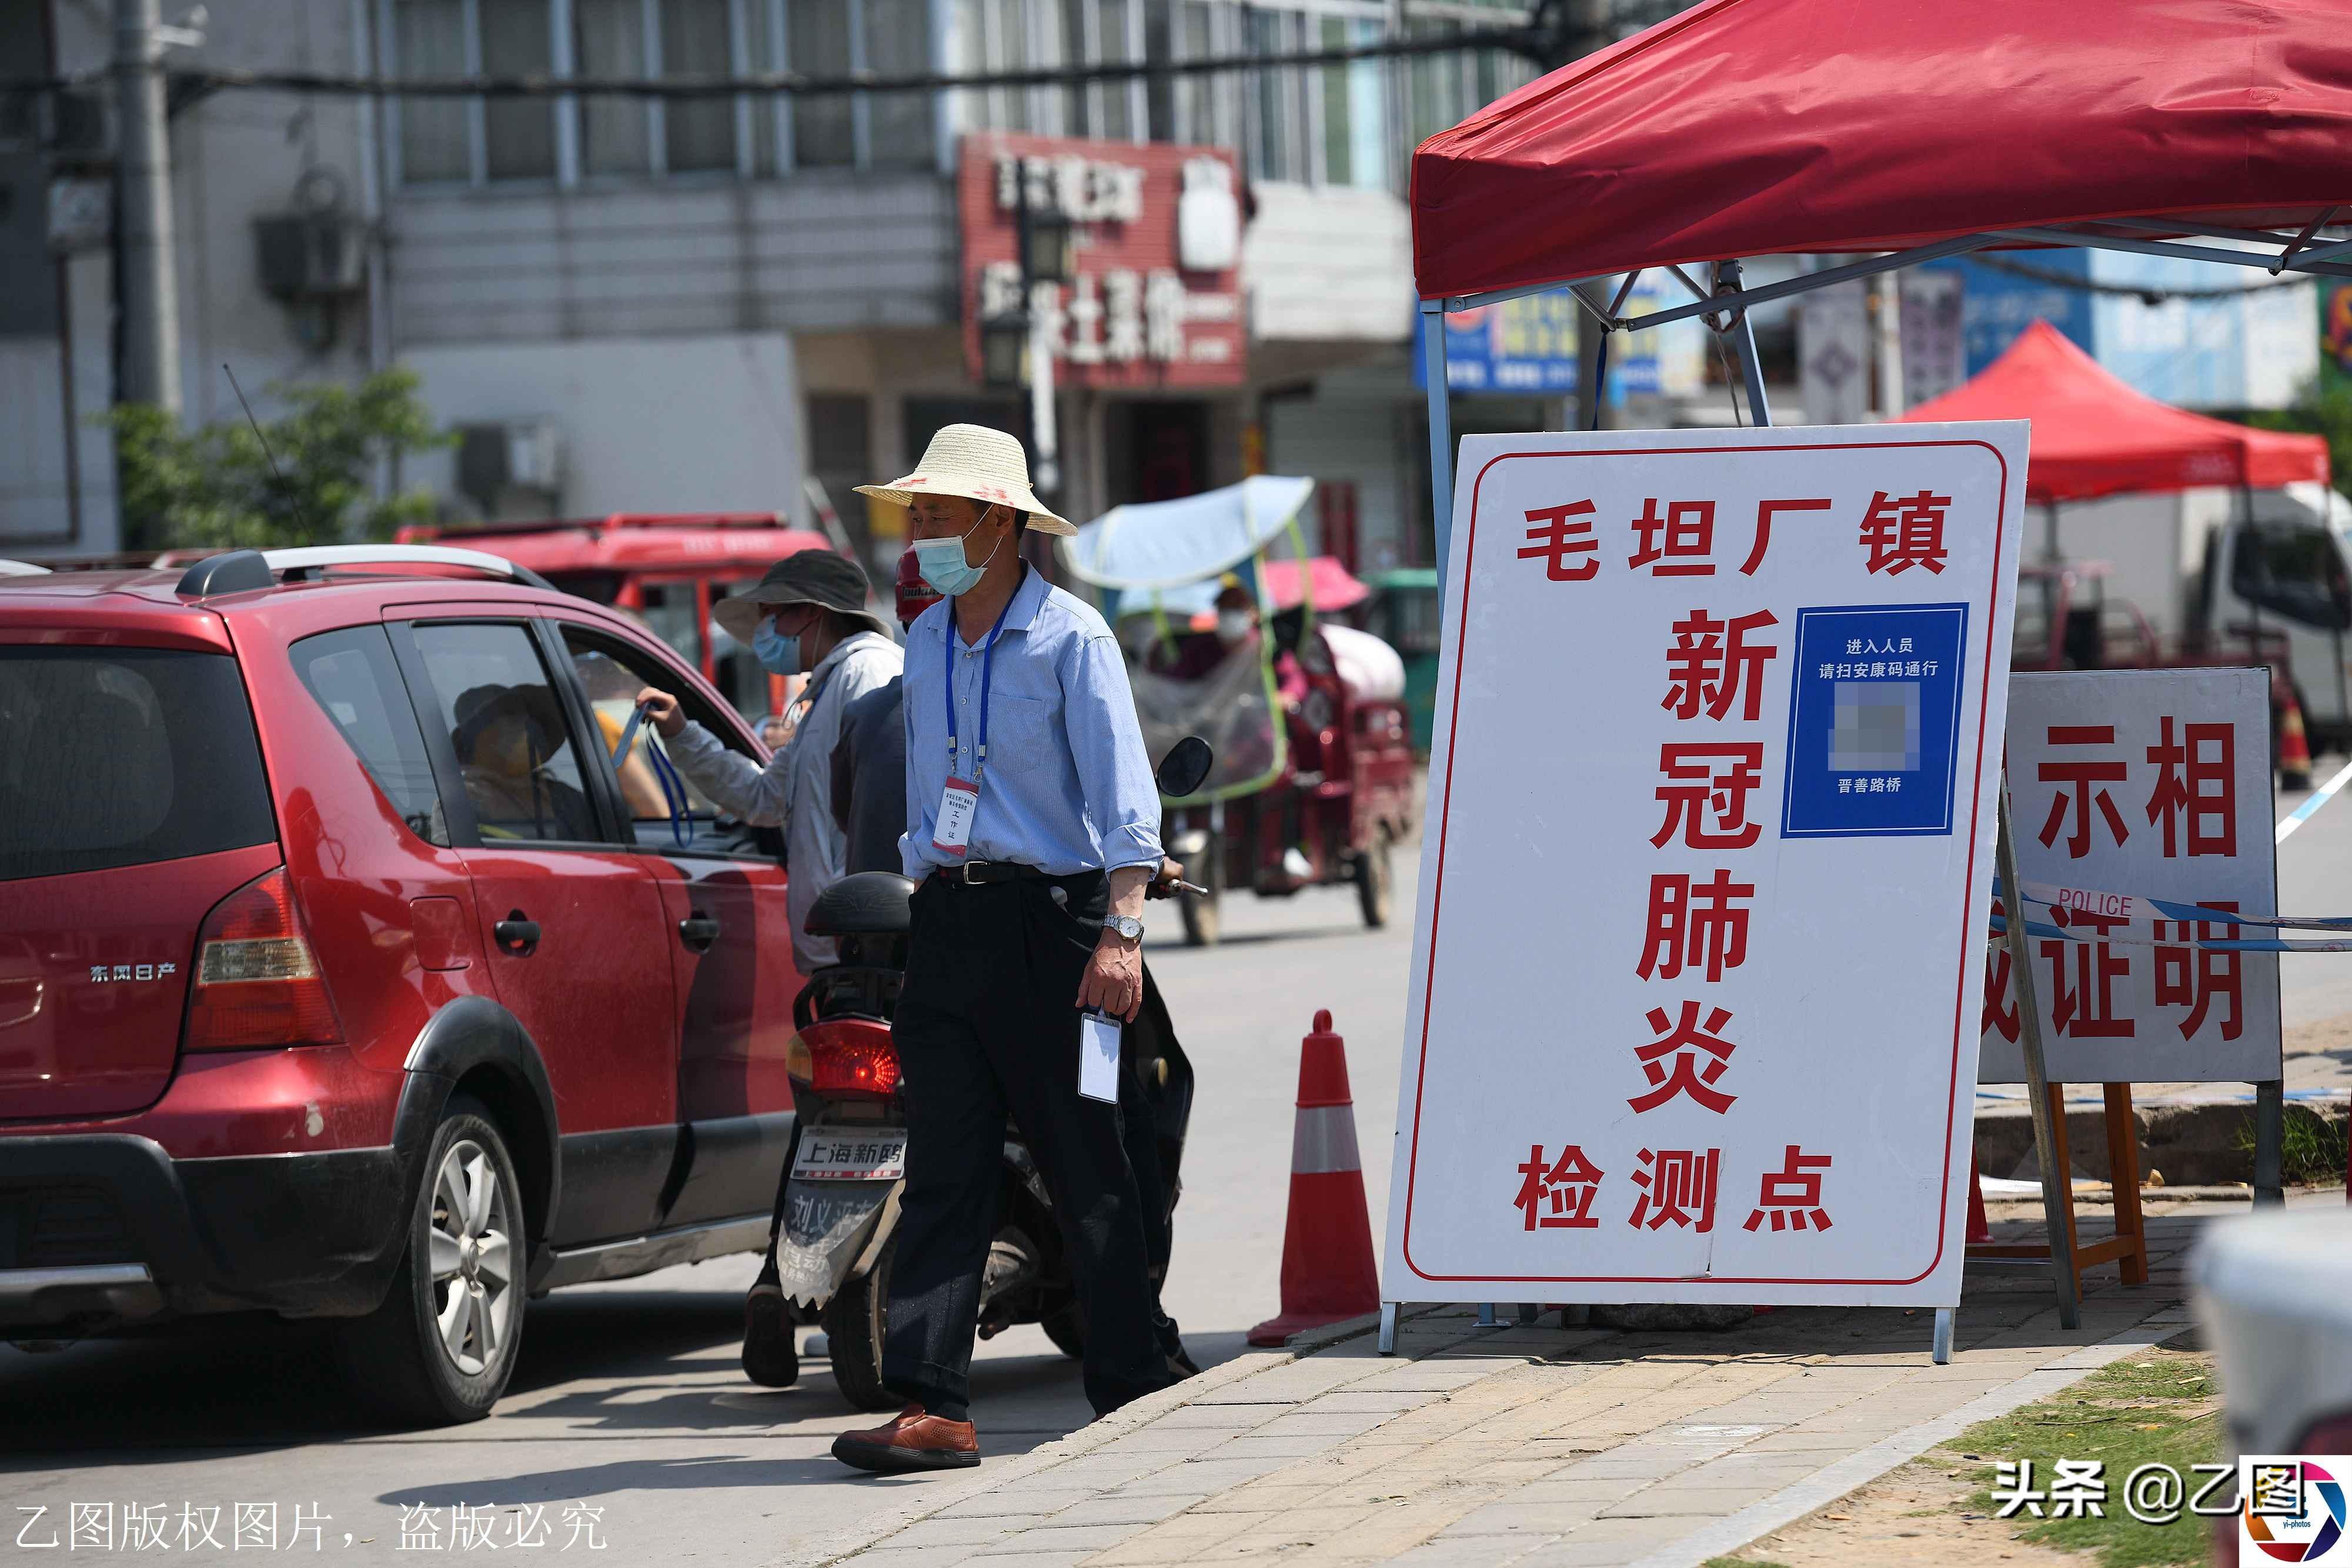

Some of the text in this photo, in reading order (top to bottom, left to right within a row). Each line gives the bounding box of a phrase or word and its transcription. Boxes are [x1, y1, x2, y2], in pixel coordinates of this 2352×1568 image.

[1516, 490, 1952, 581] 毛坦厂镇
[1846, 637, 1913, 654] 进入人员
[1819, 660, 1939, 679] 请扫安康码通行
[1838, 777, 1901, 794] 晋善路桥
[2002, 716, 2237, 859] 示相
[947, 810, 960, 840] 工作证
[1626, 609, 1780, 1115] 新冠肺炎
[2059, 889, 2133, 917] POLICE
[90, 962, 176, 982] 东风日产
[1513, 1144, 1833, 1233] 检测点
